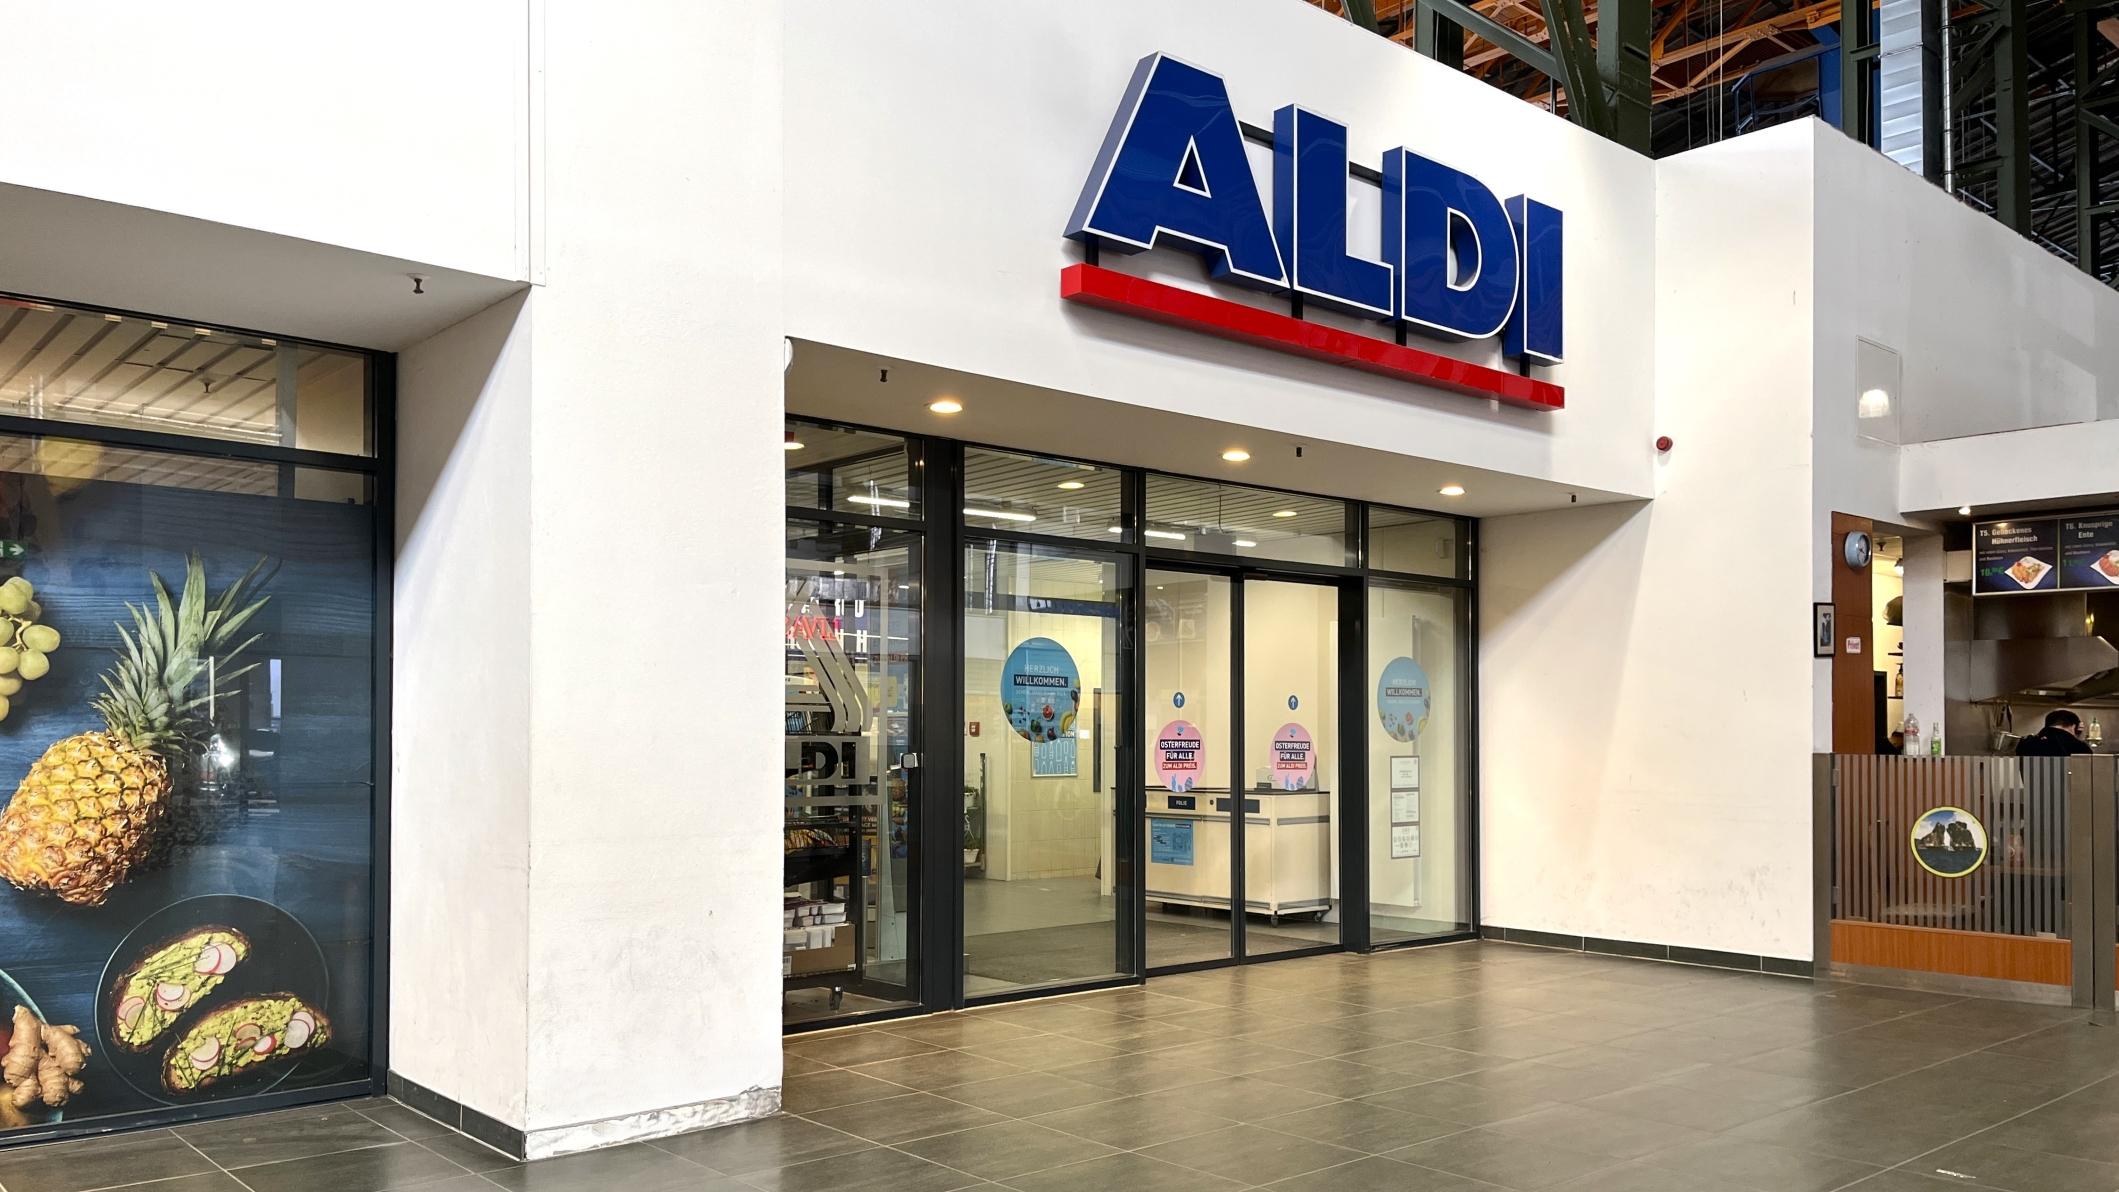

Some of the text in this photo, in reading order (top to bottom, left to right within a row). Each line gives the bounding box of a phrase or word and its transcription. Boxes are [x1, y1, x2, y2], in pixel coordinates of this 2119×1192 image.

[1063, 52, 1563, 366] ALDI
[1024, 664, 1059, 674] HERZLICH
[1015, 675, 1067, 687] WILLKOMMEN.
[1160, 741, 1200, 749] OSTERFREUDE
[1275, 742, 1310, 750] OSTERFREUDE
[1166, 751, 1178, 759] FÜR
[1280, 751, 1291, 760] FÜR
[785, 742, 857, 779] DI
